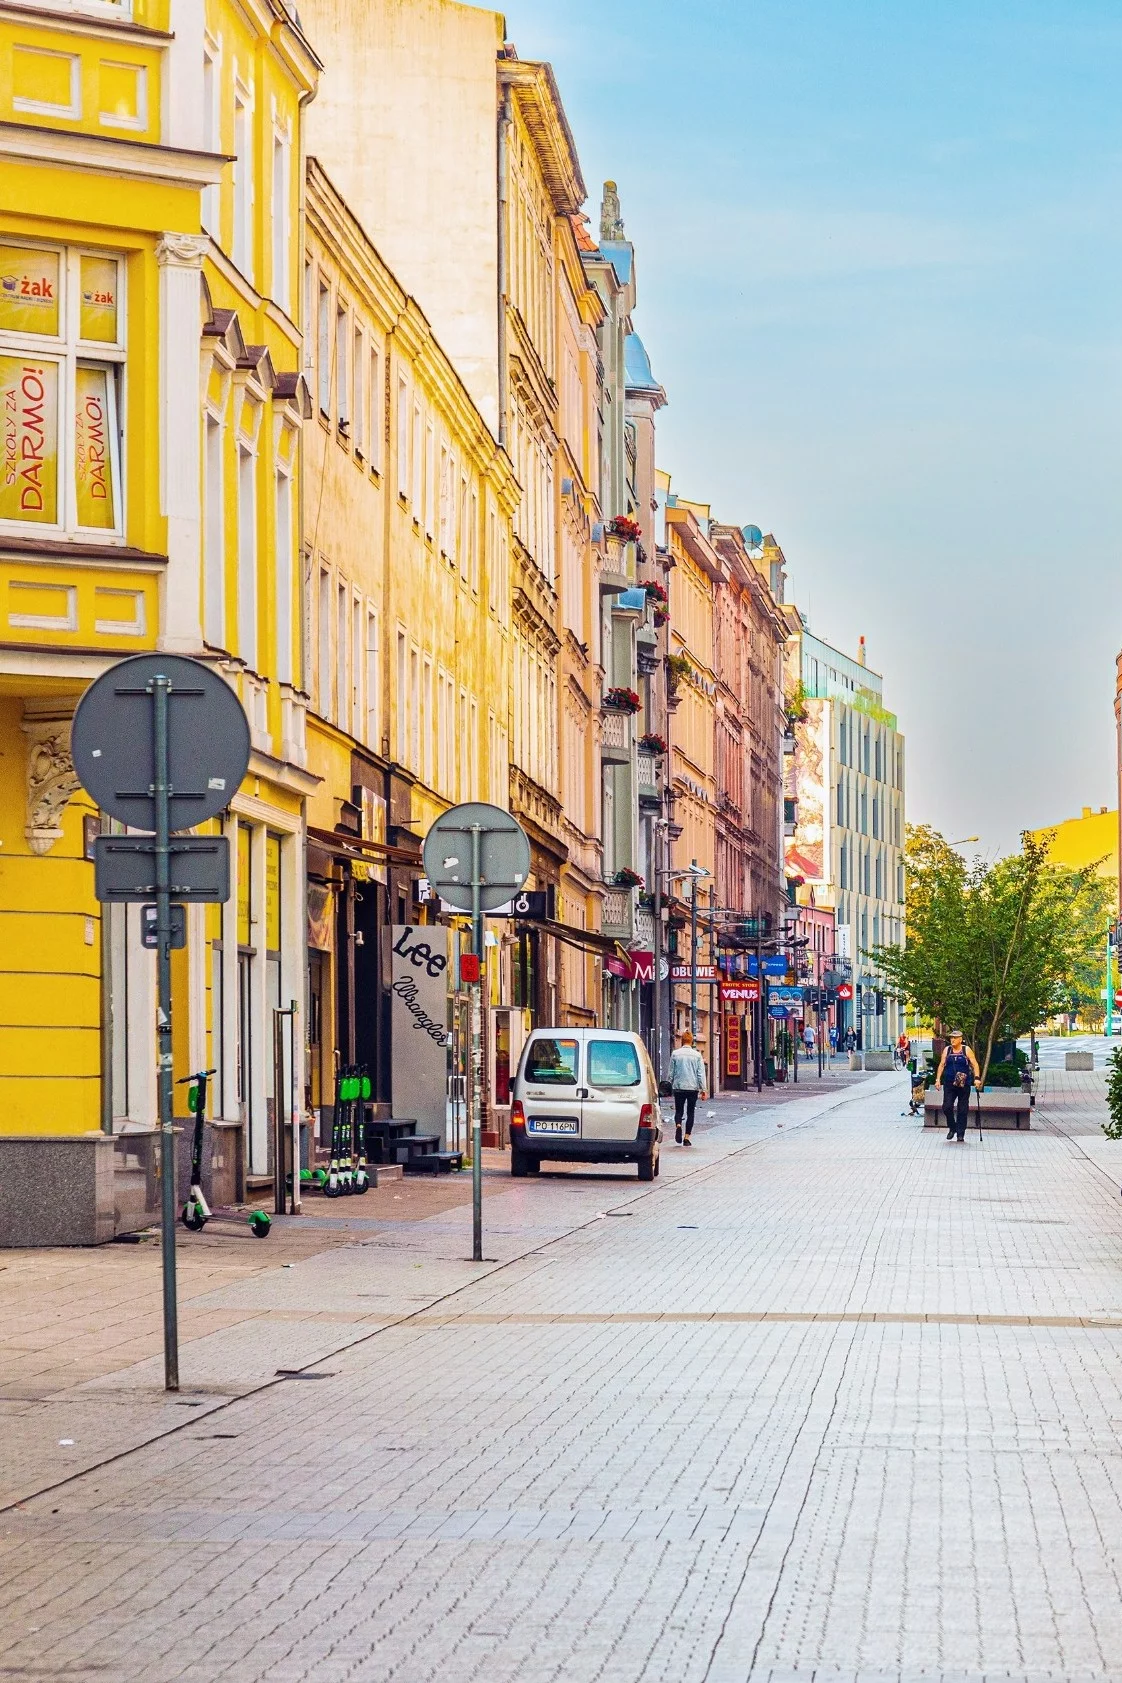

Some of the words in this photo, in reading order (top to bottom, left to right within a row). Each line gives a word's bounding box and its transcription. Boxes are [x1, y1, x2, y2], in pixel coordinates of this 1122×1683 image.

[21, 275, 53, 298] żak
[94, 291, 114, 304] żak
[6, 389, 17, 413] ZA
[21, 367, 45, 512] DARMO!
[86, 396, 107, 499] DARMO!
[6, 419, 18, 486] SZKOŁY
[392, 926, 447, 978] Lee
[672, 966, 715, 977] OBUWIE
[721, 989, 759, 999] VENUS
[392, 975, 448, 1048] Wrangler
[535, 1121, 547, 1130] PO
[550, 1121, 575, 1131] 116PN
